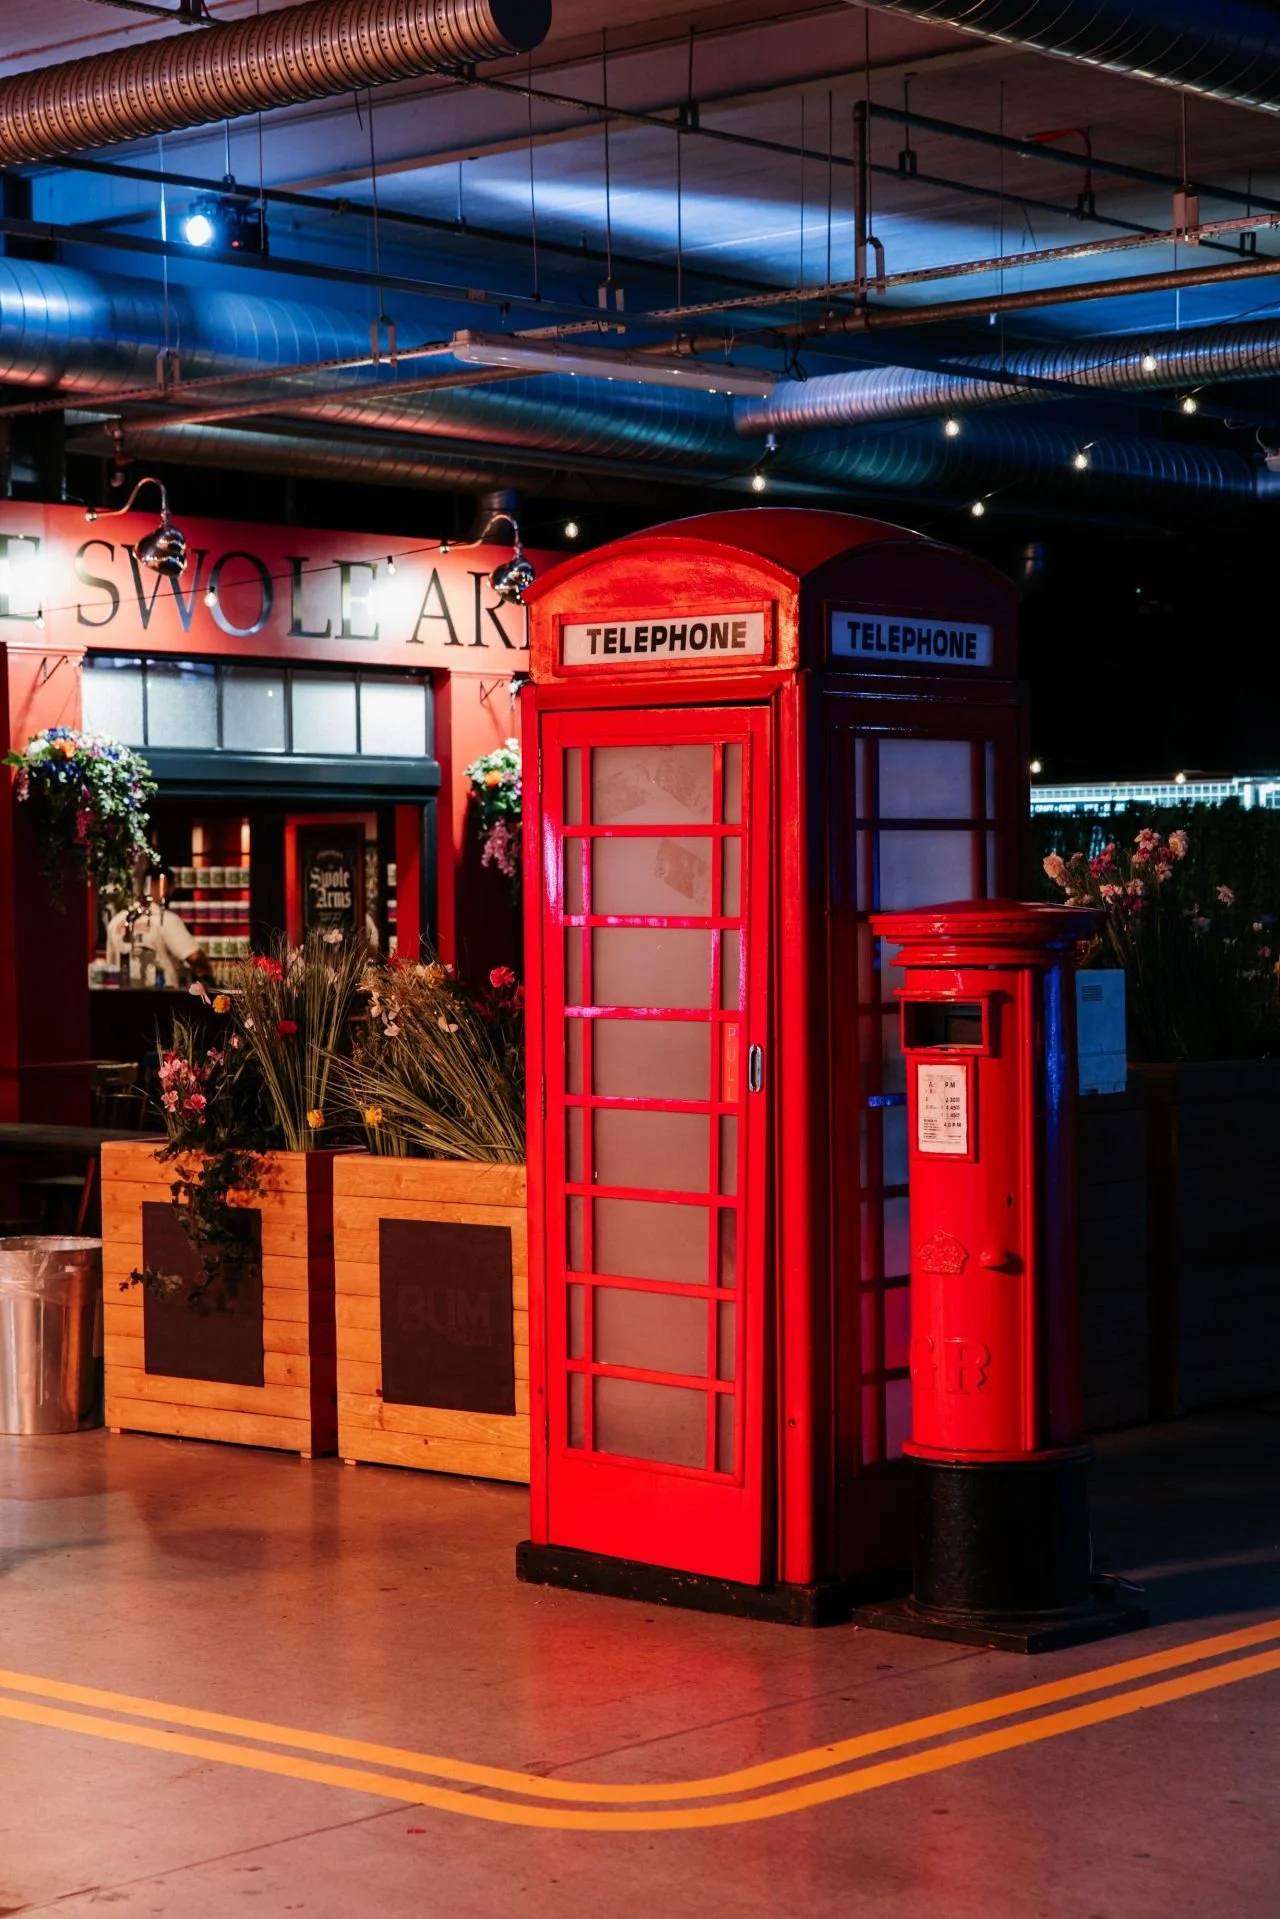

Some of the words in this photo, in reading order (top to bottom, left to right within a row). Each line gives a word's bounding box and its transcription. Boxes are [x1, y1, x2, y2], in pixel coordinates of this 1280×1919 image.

[74, 539, 379, 641] SWOLE
[586, 621, 747, 655] TELEPHONE
[847, 621, 977, 659] TELEPHONE
[309, 866, 350, 889] Swole
[316, 887, 351, 909] Arms
[727, 1027, 736, 1102] PULL
